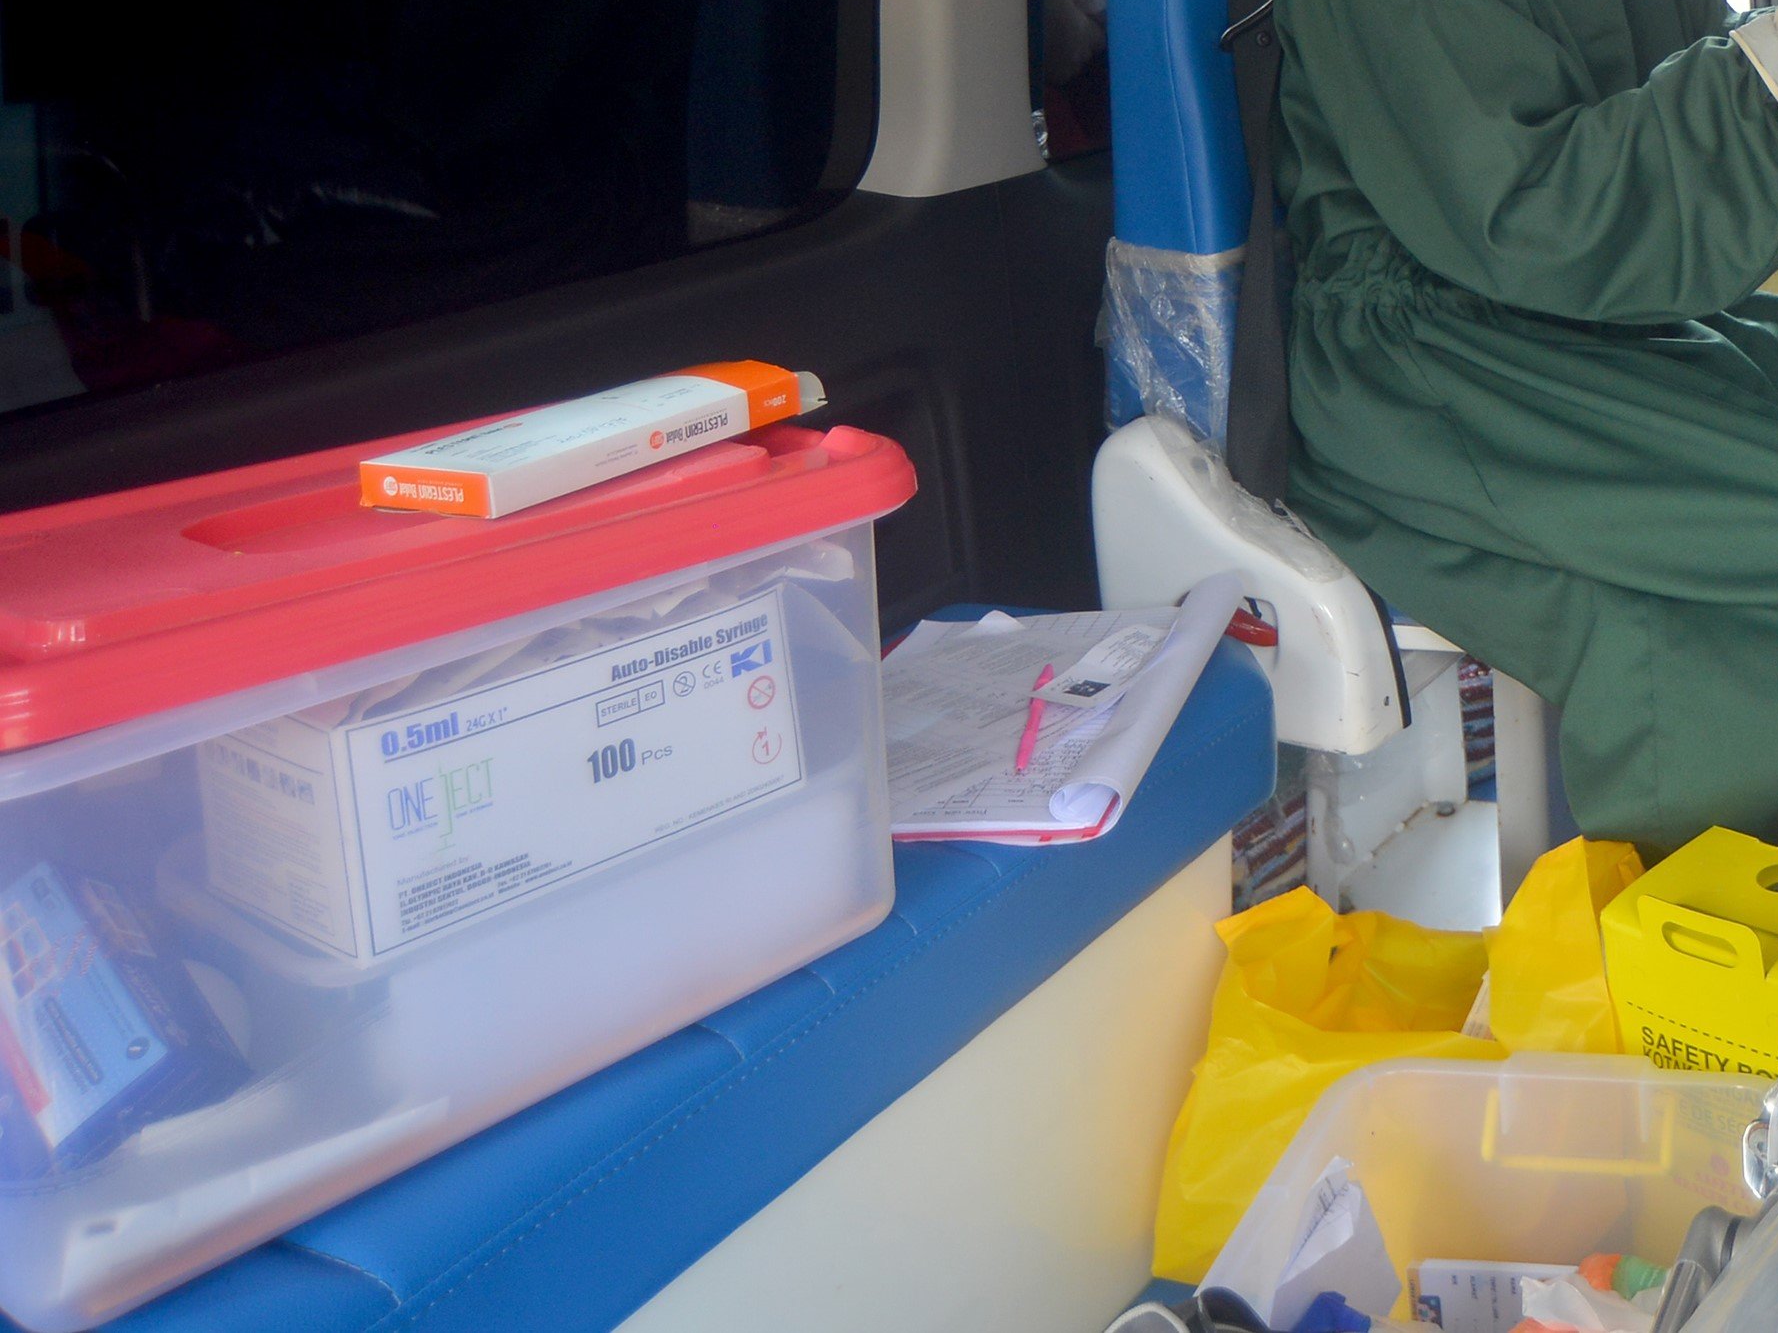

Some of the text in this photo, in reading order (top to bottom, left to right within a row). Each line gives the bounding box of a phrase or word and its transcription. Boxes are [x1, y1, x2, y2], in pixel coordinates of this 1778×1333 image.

[685, 413, 728, 439] PLESTERIN
[419, 484, 464, 503] PLESTERIN
[612, 614, 768, 682] Auto-Disable Syringe
[601, 691, 657, 717] STERILE EO
[381, 711, 459, 755] 0.5ml
[466, 715, 487, 732] 24G
[587, 738, 673, 784] 100 Pcs
[444, 862, 483, 883] INDONESIA
[1641, 1026, 1729, 1071] SAFETY
